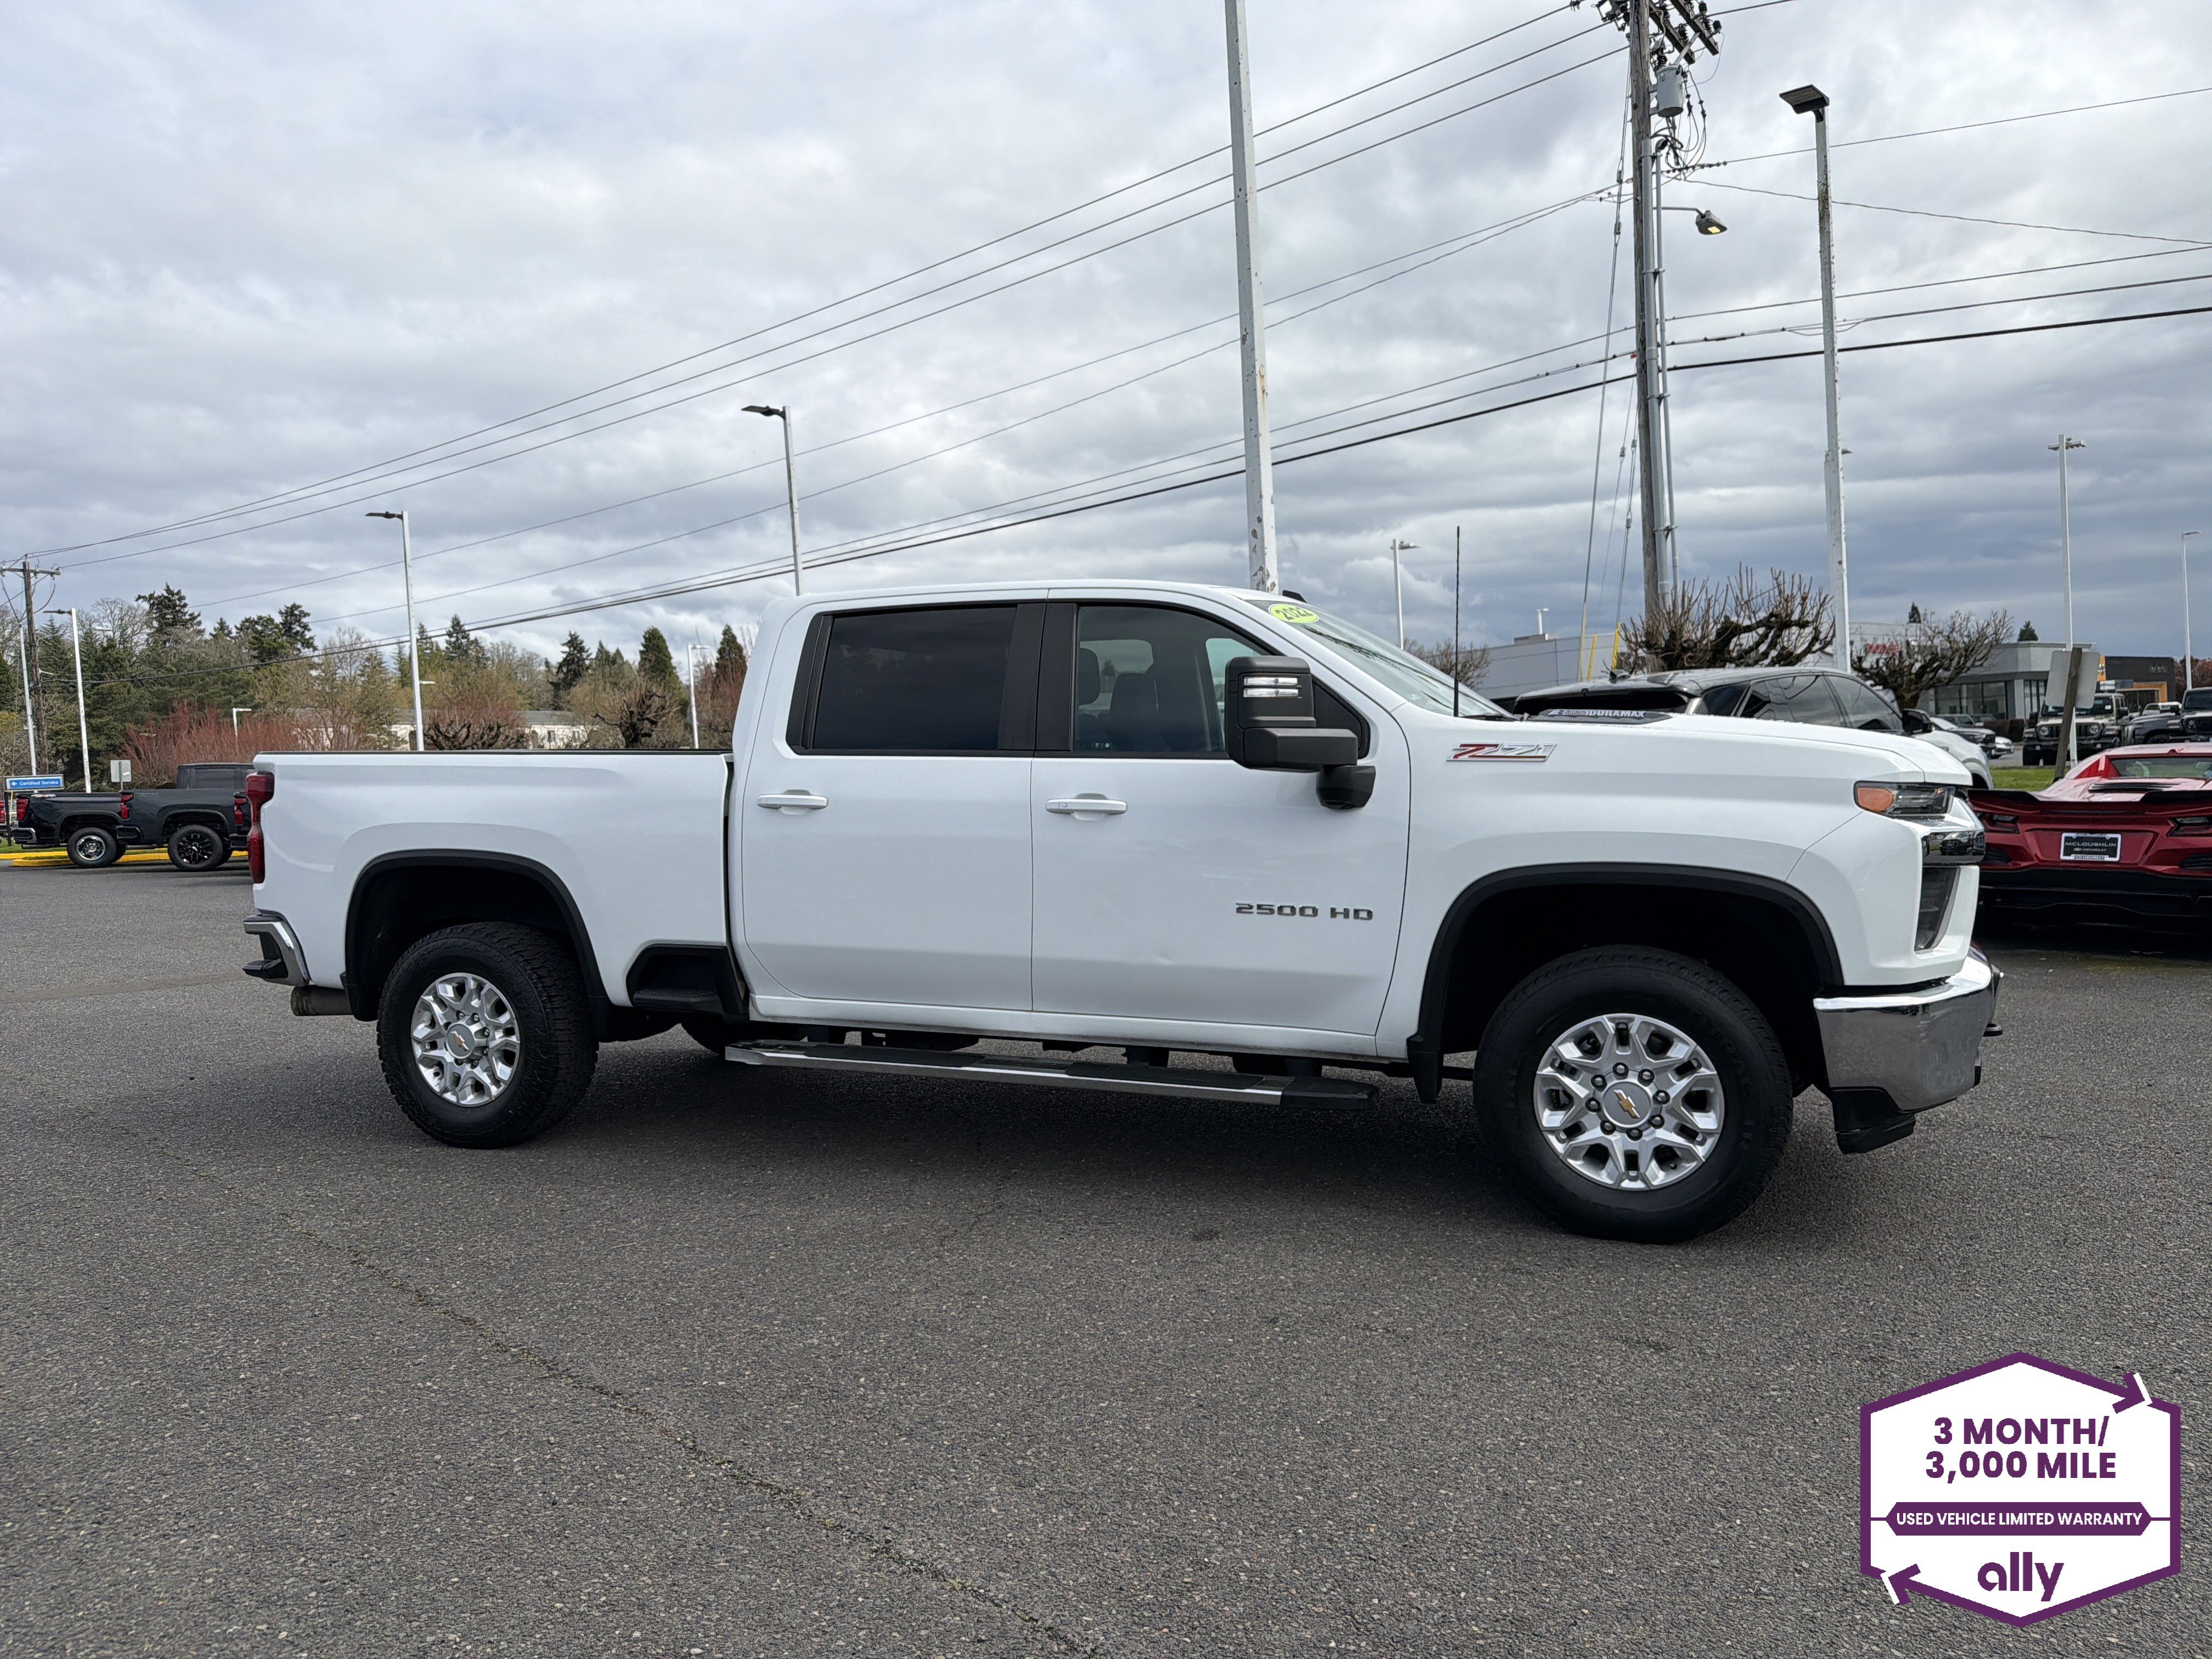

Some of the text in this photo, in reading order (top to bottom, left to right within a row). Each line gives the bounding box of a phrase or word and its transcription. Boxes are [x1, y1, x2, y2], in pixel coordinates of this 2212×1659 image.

[1274, 607, 1314, 620] 2022
[1446, 742, 1557, 762] Z71
[1235, 902, 1373, 921] 2500 HD
